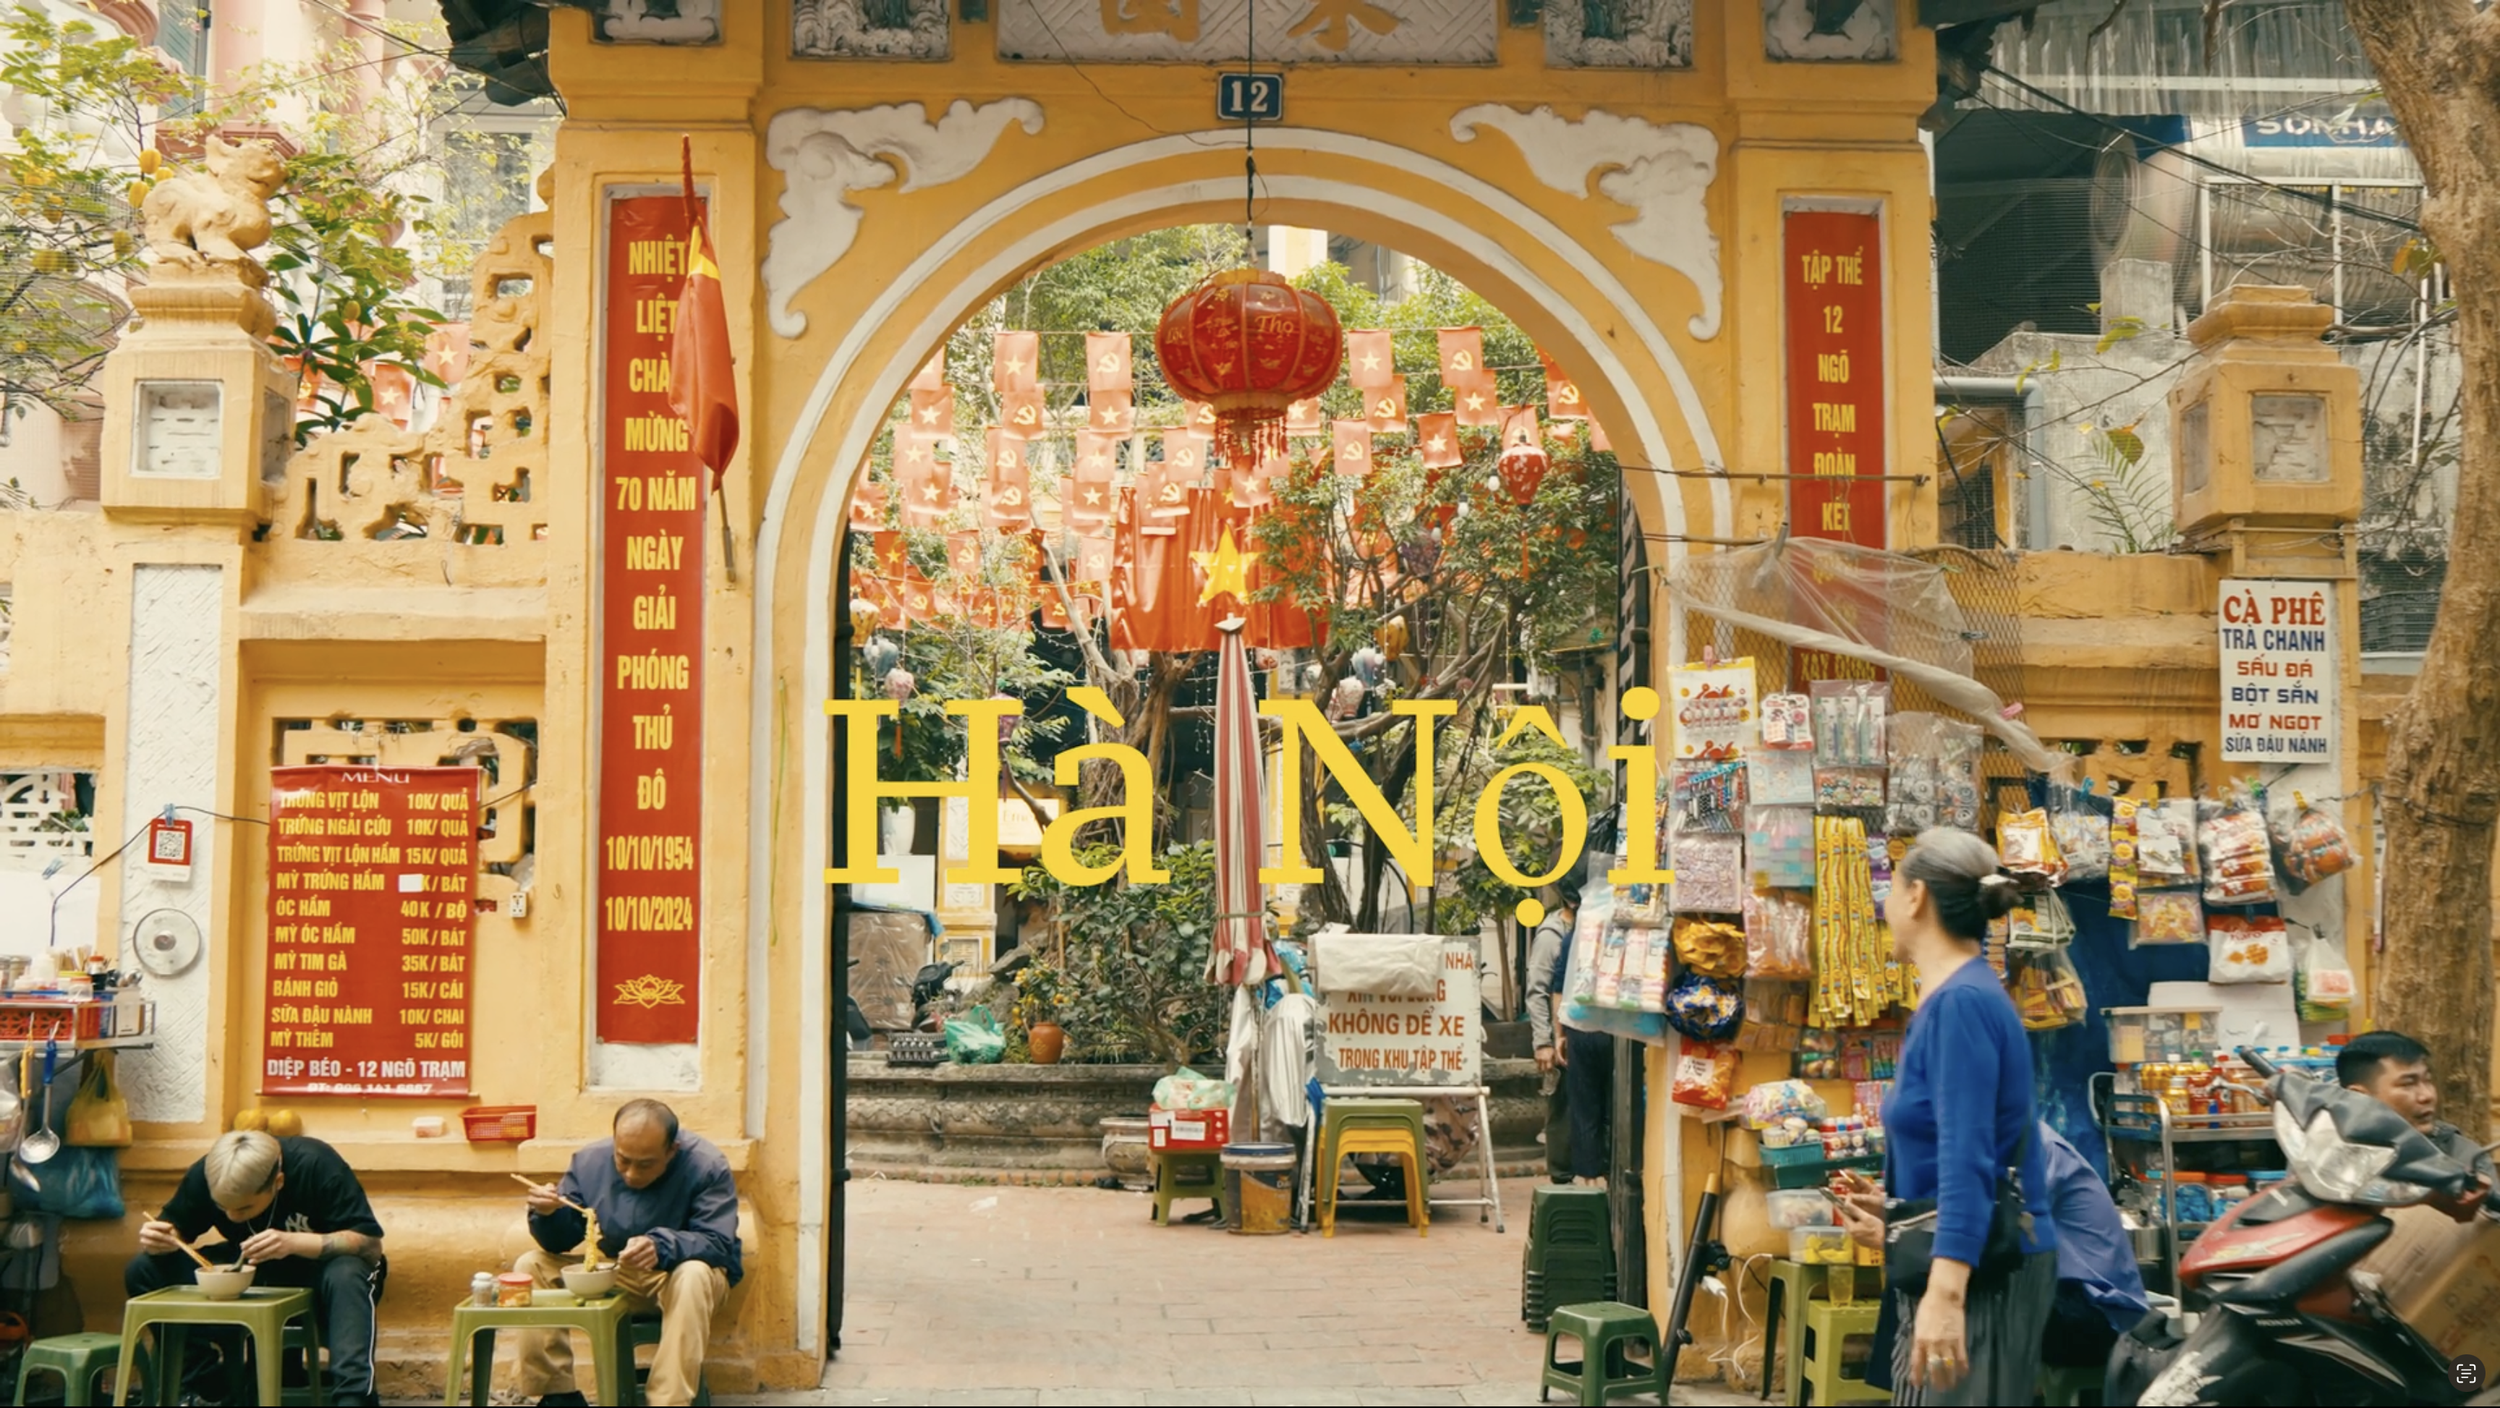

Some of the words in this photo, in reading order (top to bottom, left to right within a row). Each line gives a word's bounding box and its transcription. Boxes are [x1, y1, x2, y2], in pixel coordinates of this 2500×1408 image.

[1231, 81, 1269, 113] 12
[628, 234, 686, 282] NHIỆT
[1802, 249, 1832, 290] TẬP
[1836, 246, 1863, 285] THỂ
[636, 293, 677, 341] LIỆT
[1254, 314, 1294, 337] Thọ
[1823, 305, 1843, 333] 12
[629, 352, 671, 393] CHÀ
[1818, 349, 1849, 383] NGÕ
[625, 411, 689, 452] MỪNG
[1812, 403, 1855, 438] TRẠM
[615, 477, 642, 511] 70
[648, 470, 696, 511] NĂM
[626, 529, 684, 570] NGÀY
[633, 584, 676, 630] GIẢI
[2223, 589, 2262, 624] CÀ
[2270, 591, 2326, 625] PHÊ
[2222, 624, 2257, 650] TRÀ
[2263, 629, 2325, 651] CHANH
[617, 649, 689, 690] PHÓNG
[2237, 653, 2278, 676] SẤU
[2285, 658, 2313, 678] ĐÁ
[2231, 683, 2269, 706] BỘT
[2277, 680, 2319, 704] SẮN
[632, 704, 673, 750] THỦ
[2229, 712, 2262, 729] MƠ
[2269, 714, 2322, 734] NGỌT
[2225, 732, 2252, 752] SỮA
[2257, 734, 2284, 756] ĐẬU
[2288, 734, 2327, 753] NÀNH
[341, 772, 410, 784] MENU
[637, 768, 666, 810] ĐÔ
[328, 791, 349, 812] VỊT
[352, 788, 379, 812] LỘN
[440, 788, 469, 811] QUẢ
[278, 814, 324, 835] TRỨNG
[327, 812, 361, 835] NGẢI
[364, 815, 391, 835] CỨU
[440, 813, 469, 838] QUẢ
[276, 842, 320, 862] TRỨNG
[323, 847, 342, 866] VỊT
[345, 843, 369, 867] LỘN
[440, 841, 468, 866] QUẢ
[606, 835, 693, 870] 10/10/1954
[276, 869, 299, 889] MỲ
[303, 869, 349, 890] TRỨNG
[441, 873, 467, 892] BÁT
[446, 899, 467, 922] BỘ
[605, 896, 692, 931] 10/10/2024
[275, 923, 297, 943] MỲ
[440, 927, 466, 946] BÁT
[274, 950, 296, 970] MỲ
[300, 953, 324, 971] TIM
[328, 950, 347, 971] GÀ
[440, 953, 465, 972] BÁT
[273, 976, 311, 997] BÁNH
[315, 976, 338, 998] GIÒ
[439, 979, 464, 999] CÁI
[271, 1003, 299, 1023] SỮA
[302, 1005, 330, 1027] ĐẬU
[333, 1005, 372, 1024] NÀNH
[433, 1009, 464, 1025] CHAI
[1328, 1008, 1399, 1035] KHÔNG
[1405, 1006, 1435, 1036] ĐỂ
[1438, 1015, 1464, 1037] XE
[270, 1028, 291, 1047] MỲ
[295, 1029, 333, 1048] THÊM
[441, 1029, 464, 1048] GÓI
[267, 1056, 304, 1080] DIỆP
[308, 1057, 341, 1077] BÉO
[357, 1061, 378, 1078] 12
[381, 1058, 415, 1078] NGÕ
[420, 1061, 466, 1081] TRẠM
[1339, 1048, 1379, 1069] TRONG
[1384, 1049, 1409, 1070] KHU
[1413, 1045, 1436, 1074] TẬP
[1440, 1043, 1464, 1070] THỂ
